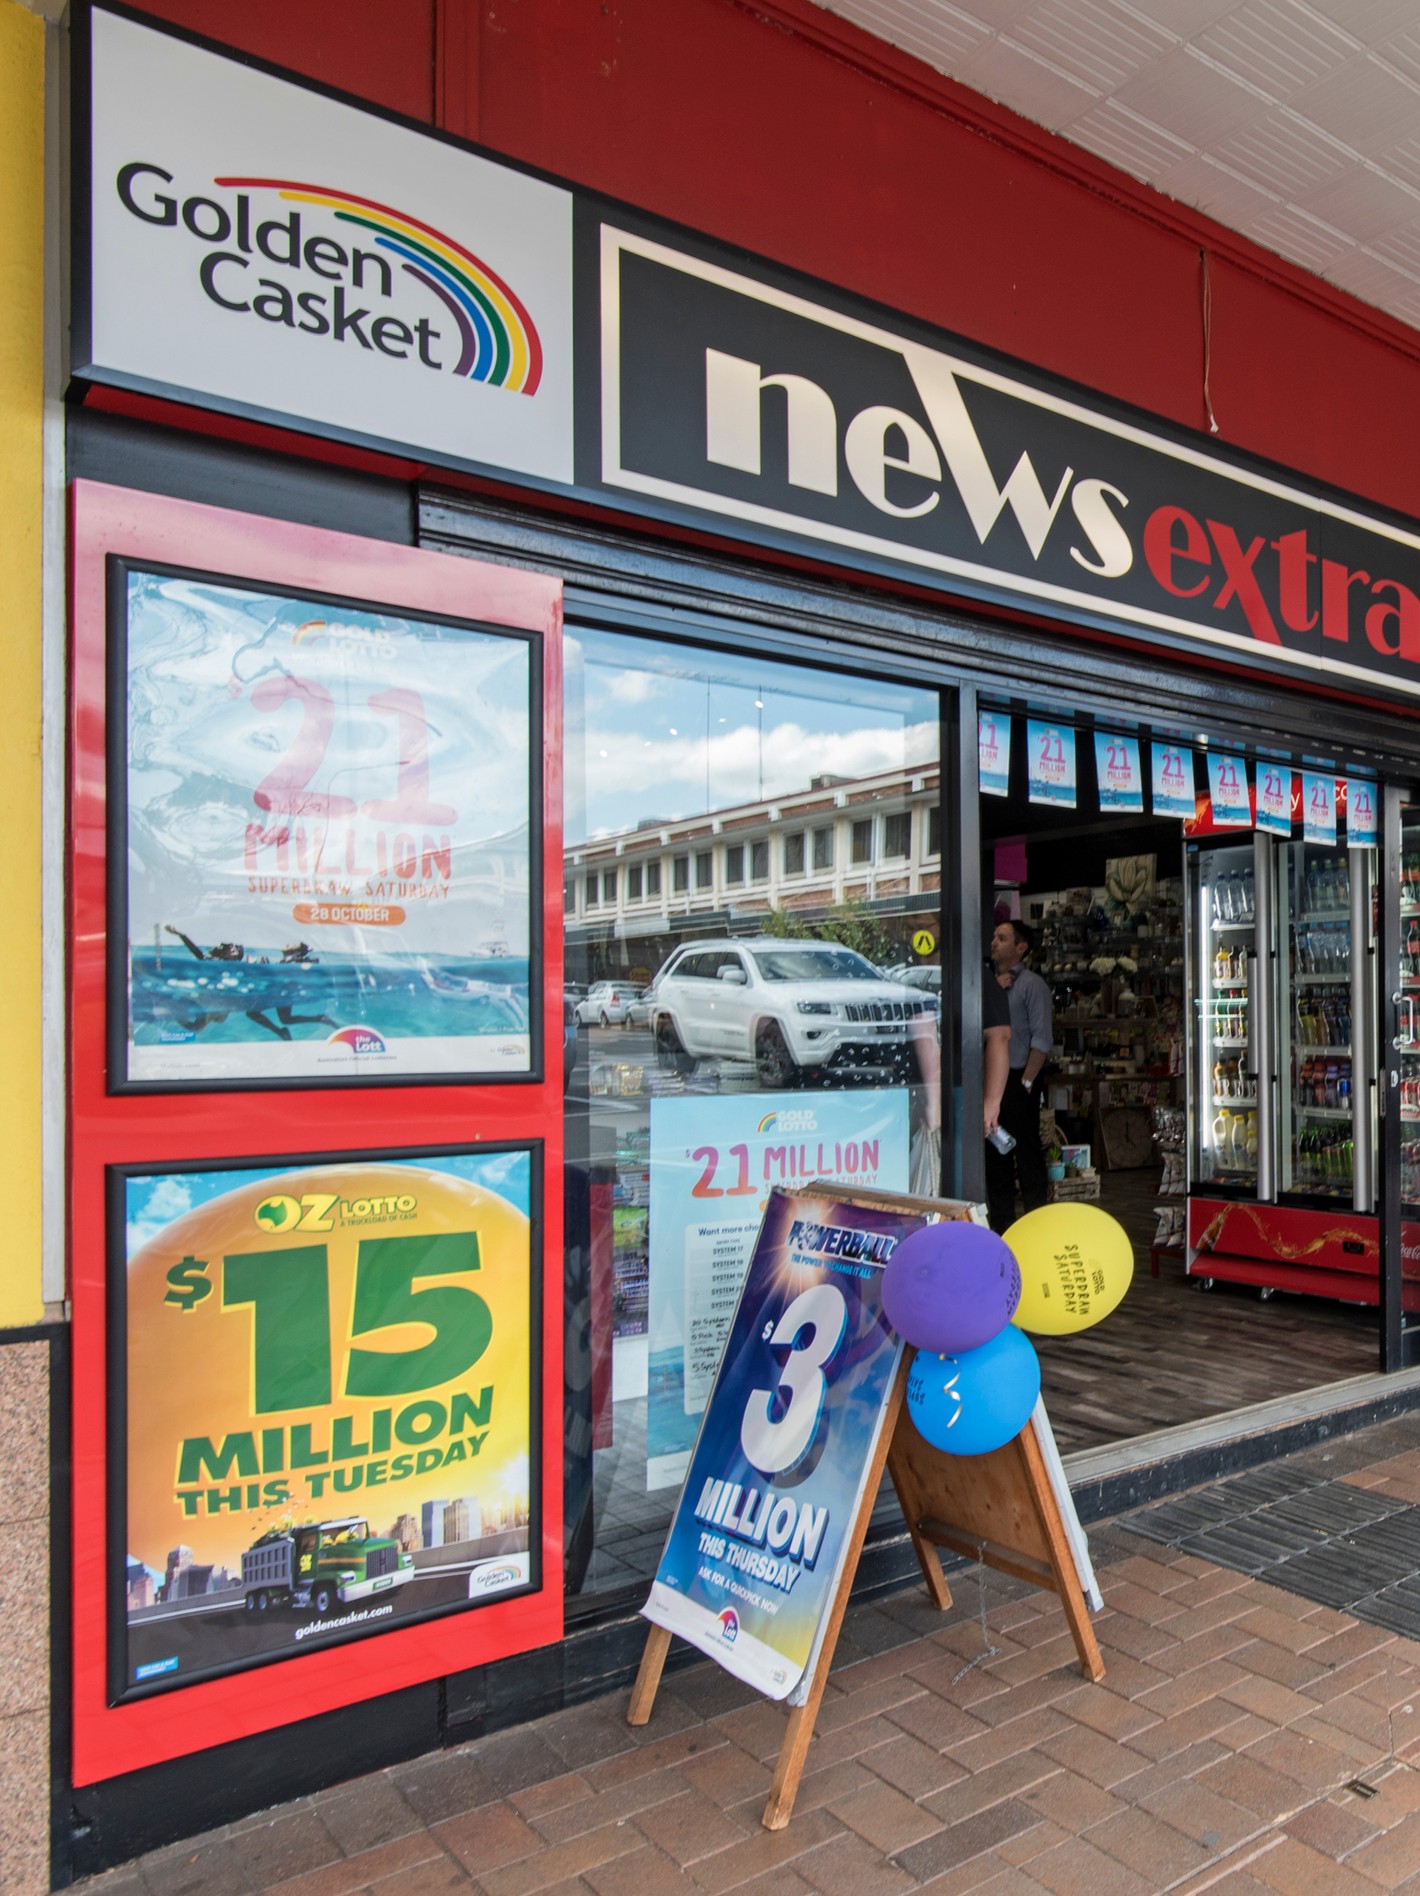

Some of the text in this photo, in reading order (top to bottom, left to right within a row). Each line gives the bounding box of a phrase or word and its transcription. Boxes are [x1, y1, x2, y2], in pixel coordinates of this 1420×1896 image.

[116, 161, 392, 298] Golden
[199, 251, 443, 370] Casket
[1039, 761, 1066, 773] MILLION
[1107, 770, 1132, 781] MILLION
[1161, 777, 1185, 789] MILLION
[1218, 787, 1240, 797] MILLION
[1263, 796, 1284, 807] MILLION
[1310, 807, 1329, 817] MILLION
[244, 823, 451, 880] MILLION
[247, 876, 450, 899] SUPERDRAW SATURDAY
[310, 907, 389, 922] 28 OCTOBER
[355, 1035, 371, 1044] the
[355, 1042, 383, 1053] Lott
[778, 1110, 814, 1121] GOLD
[778, 1119, 818, 1132] LOTTO
[763, 1139, 880, 1180] MILLION
[254, 1193, 340, 1235] OZ
[340, 1194, 418, 1219] LOTTO
[347, 1216, 388, 1227] TRUCKLOAD
[388, 1214, 397, 1222] OF
[399, 1212, 418, 1222] CASH
[698, 1227, 720, 1237] Want
[721, 1226, 743, 1235] more
[713, 1246, 736, 1255] SYSTEM
[787, 1220, 897, 1264] POWERBALL
[712, 1260, 736, 1269] SYSTEM
[791, 1253, 801, 1262] THE
[801, 1255, 822, 1268] POWER
[831, 1262, 854, 1276] CHANGE
[853, 1266, 860, 1276] IT
[859, 1267, 872, 1280] ALL
[712, 1273, 736, 1282] SYSTEM
[1053, 1254, 1077, 1314] SATURDAY
[1063, 1244, 1090, 1316] SUPERDRAW
[711, 1287, 735, 1296] SYSTEM
[711, 1300, 735, 1309] SYSTEM
[164, 1231, 494, 1414] $15
[176, 1386, 494, 1485] MILLION
[175, 1431, 490, 1517] THIS TUESDAY
[693, 1476, 829, 1563] MILLION
[698, 1533, 800, 1592] THIS THURSDAY
[698, 1566, 779, 1616] ASK FOR A QUICKPICK NOW
[295, 1604, 393, 1640] goldencasket.com
[724, 1626, 737, 1643] Lott
